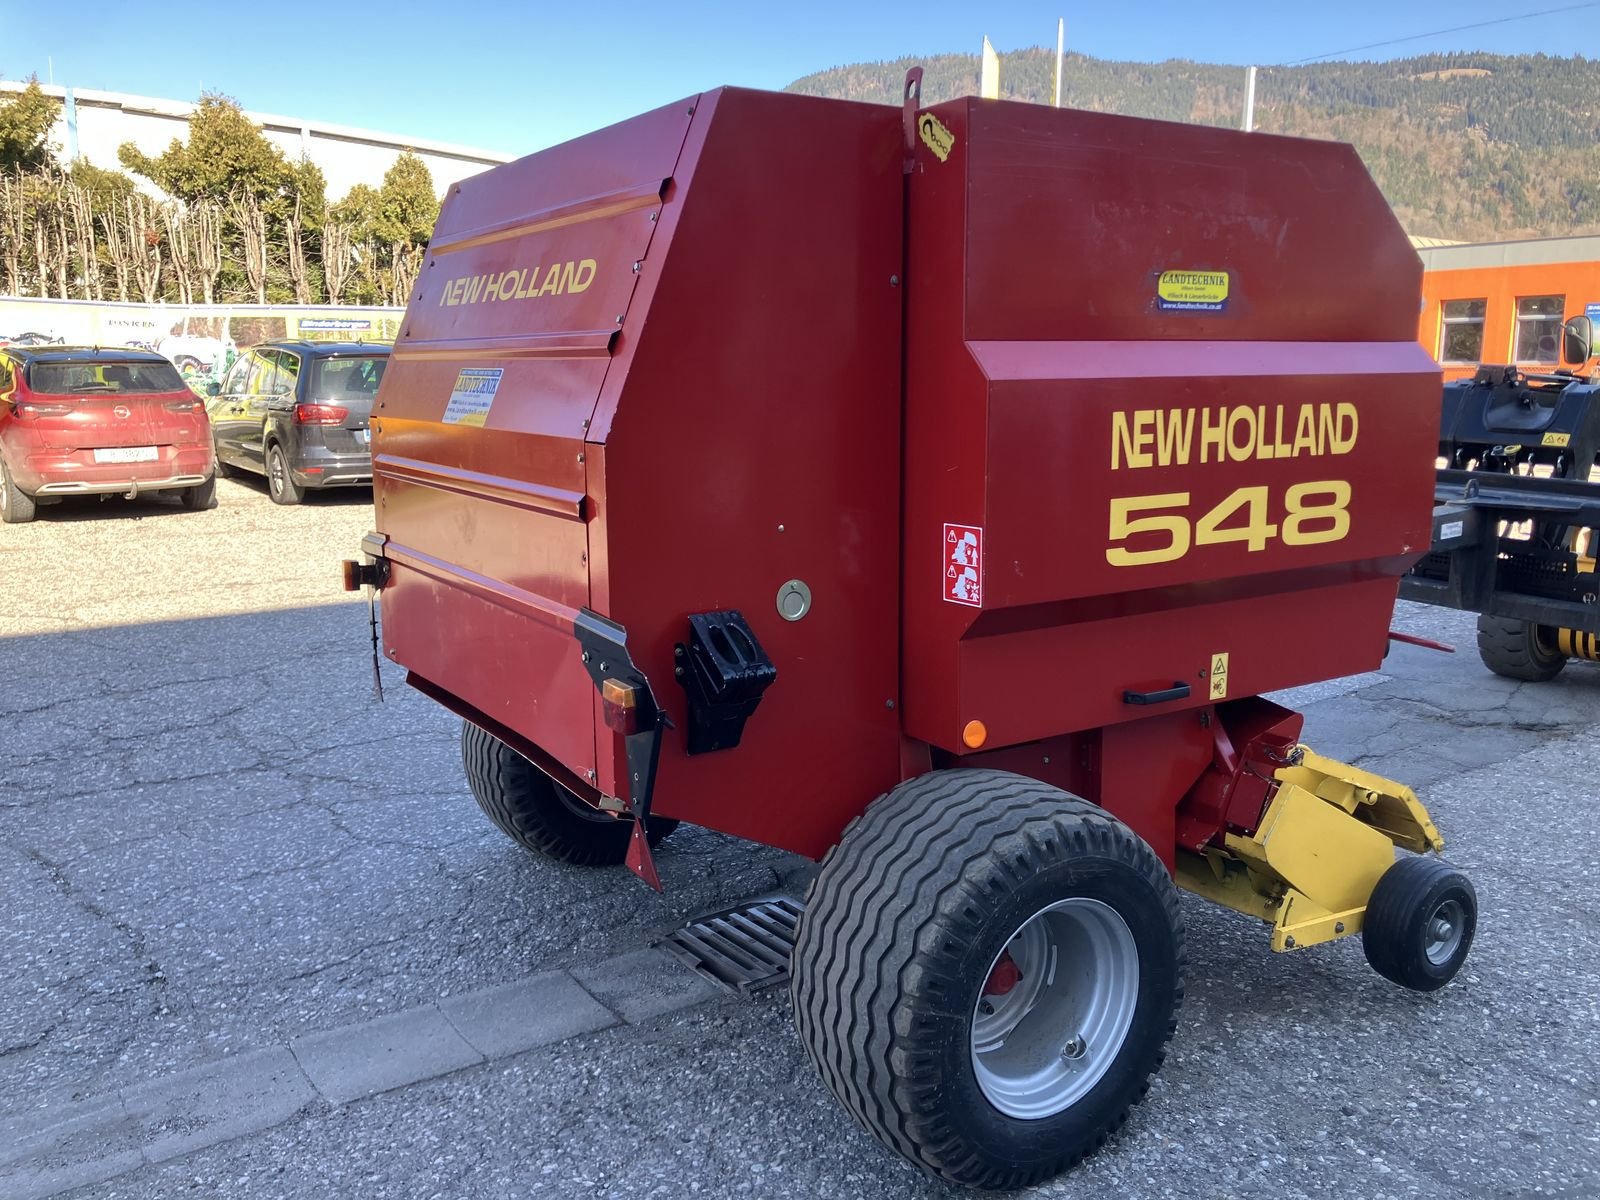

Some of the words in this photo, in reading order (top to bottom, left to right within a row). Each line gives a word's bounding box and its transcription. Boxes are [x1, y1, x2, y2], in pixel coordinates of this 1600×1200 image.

[439, 275, 486, 307] NEW
[482, 258, 597, 302] HOLLAND
[1162, 273, 1225, 286] LANDTECHNIK
[1162, 302, 1223, 310] www.landtechnik.co.at
[1110, 408, 1196, 470] NEW
[1199, 402, 1360, 463] HOLLAND
[1105, 480, 1352, 567] 548
